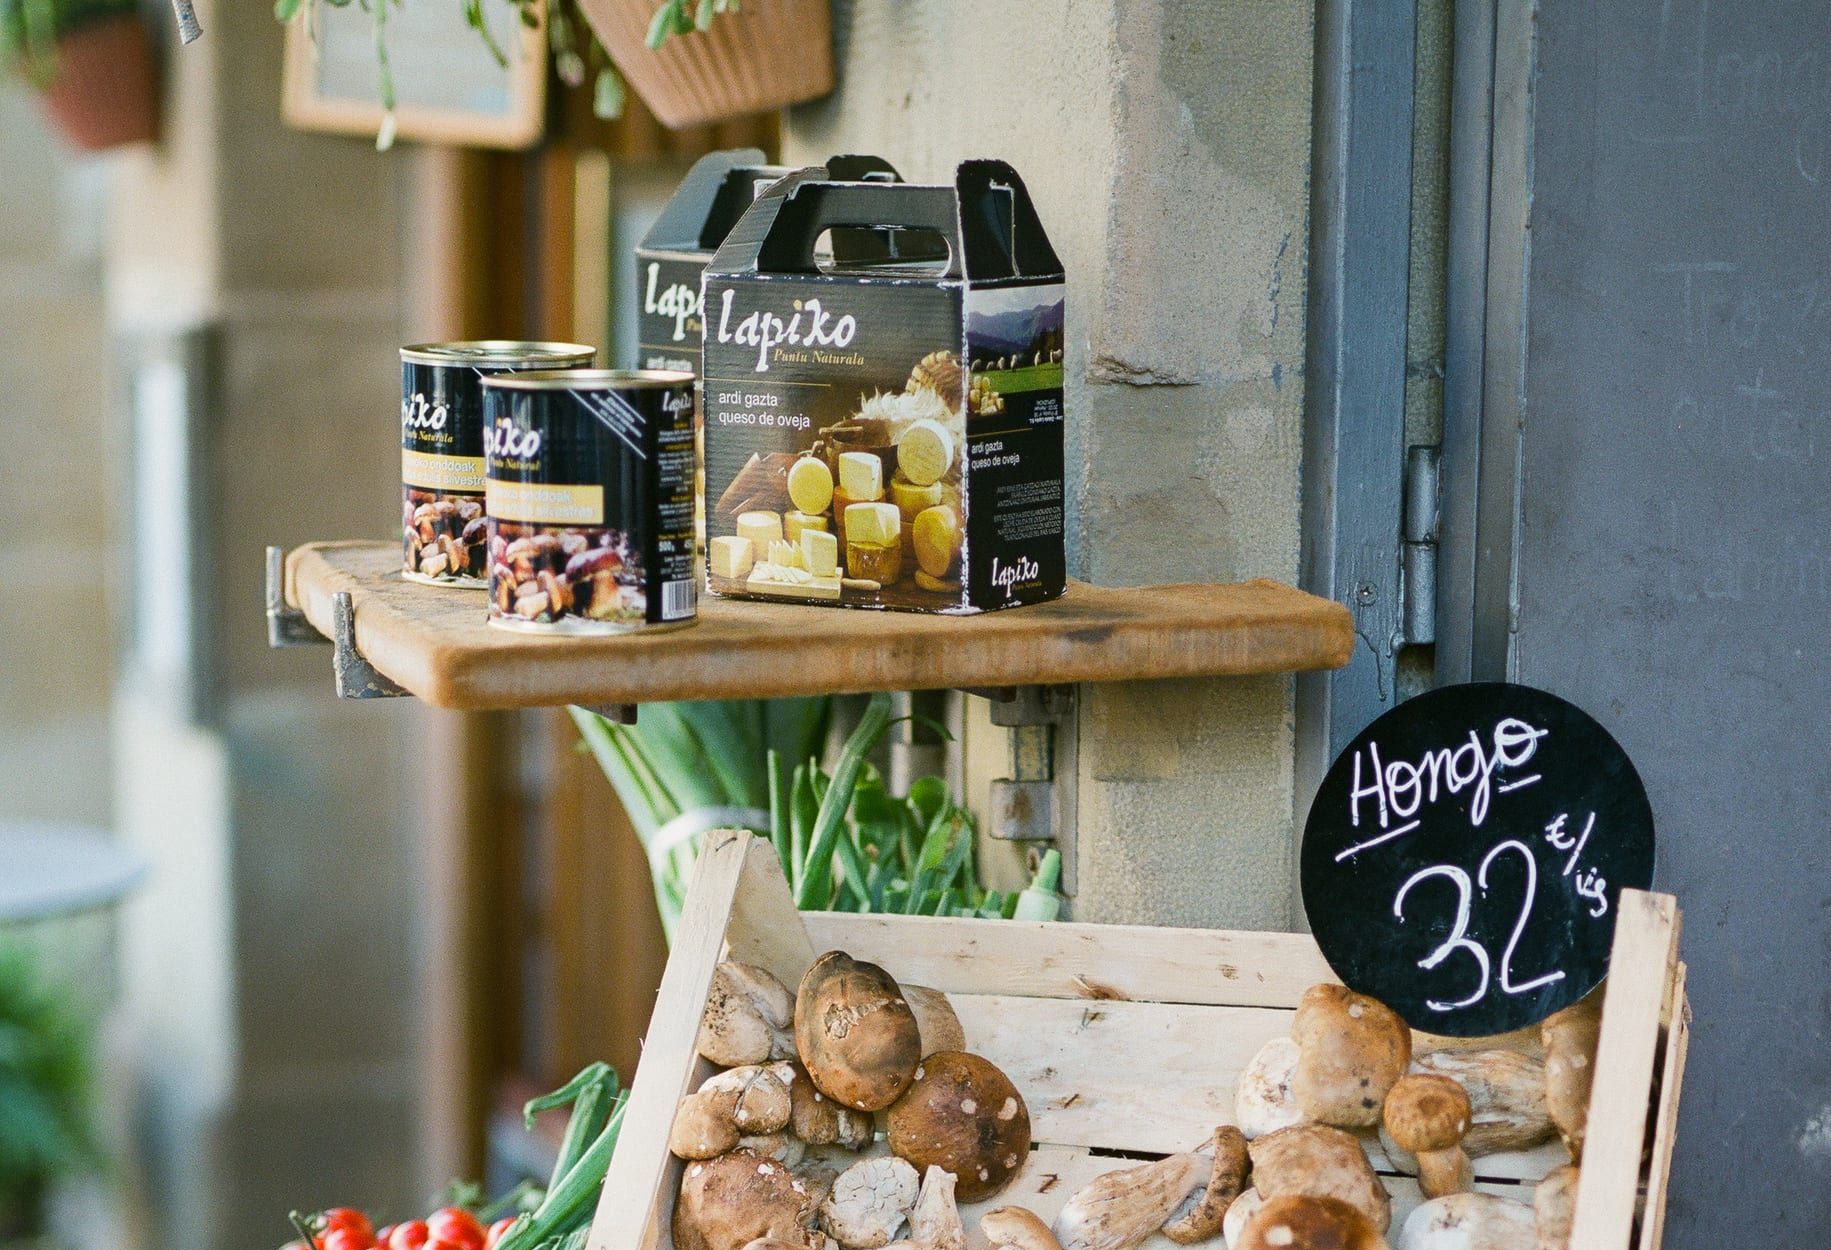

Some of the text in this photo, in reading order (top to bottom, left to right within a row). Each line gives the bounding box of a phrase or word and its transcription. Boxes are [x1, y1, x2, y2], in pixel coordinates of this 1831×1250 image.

[812, 350, 864, 365] Naturala
[718, 390, 778, 408] ardi gazta
[718, 411, 810, 431] queso de oveja
[984, 441, 1003, 455] gazta
[971, 453, 1020, 470] queso de oveja
[1394, 839, 1565, 1012] 32
